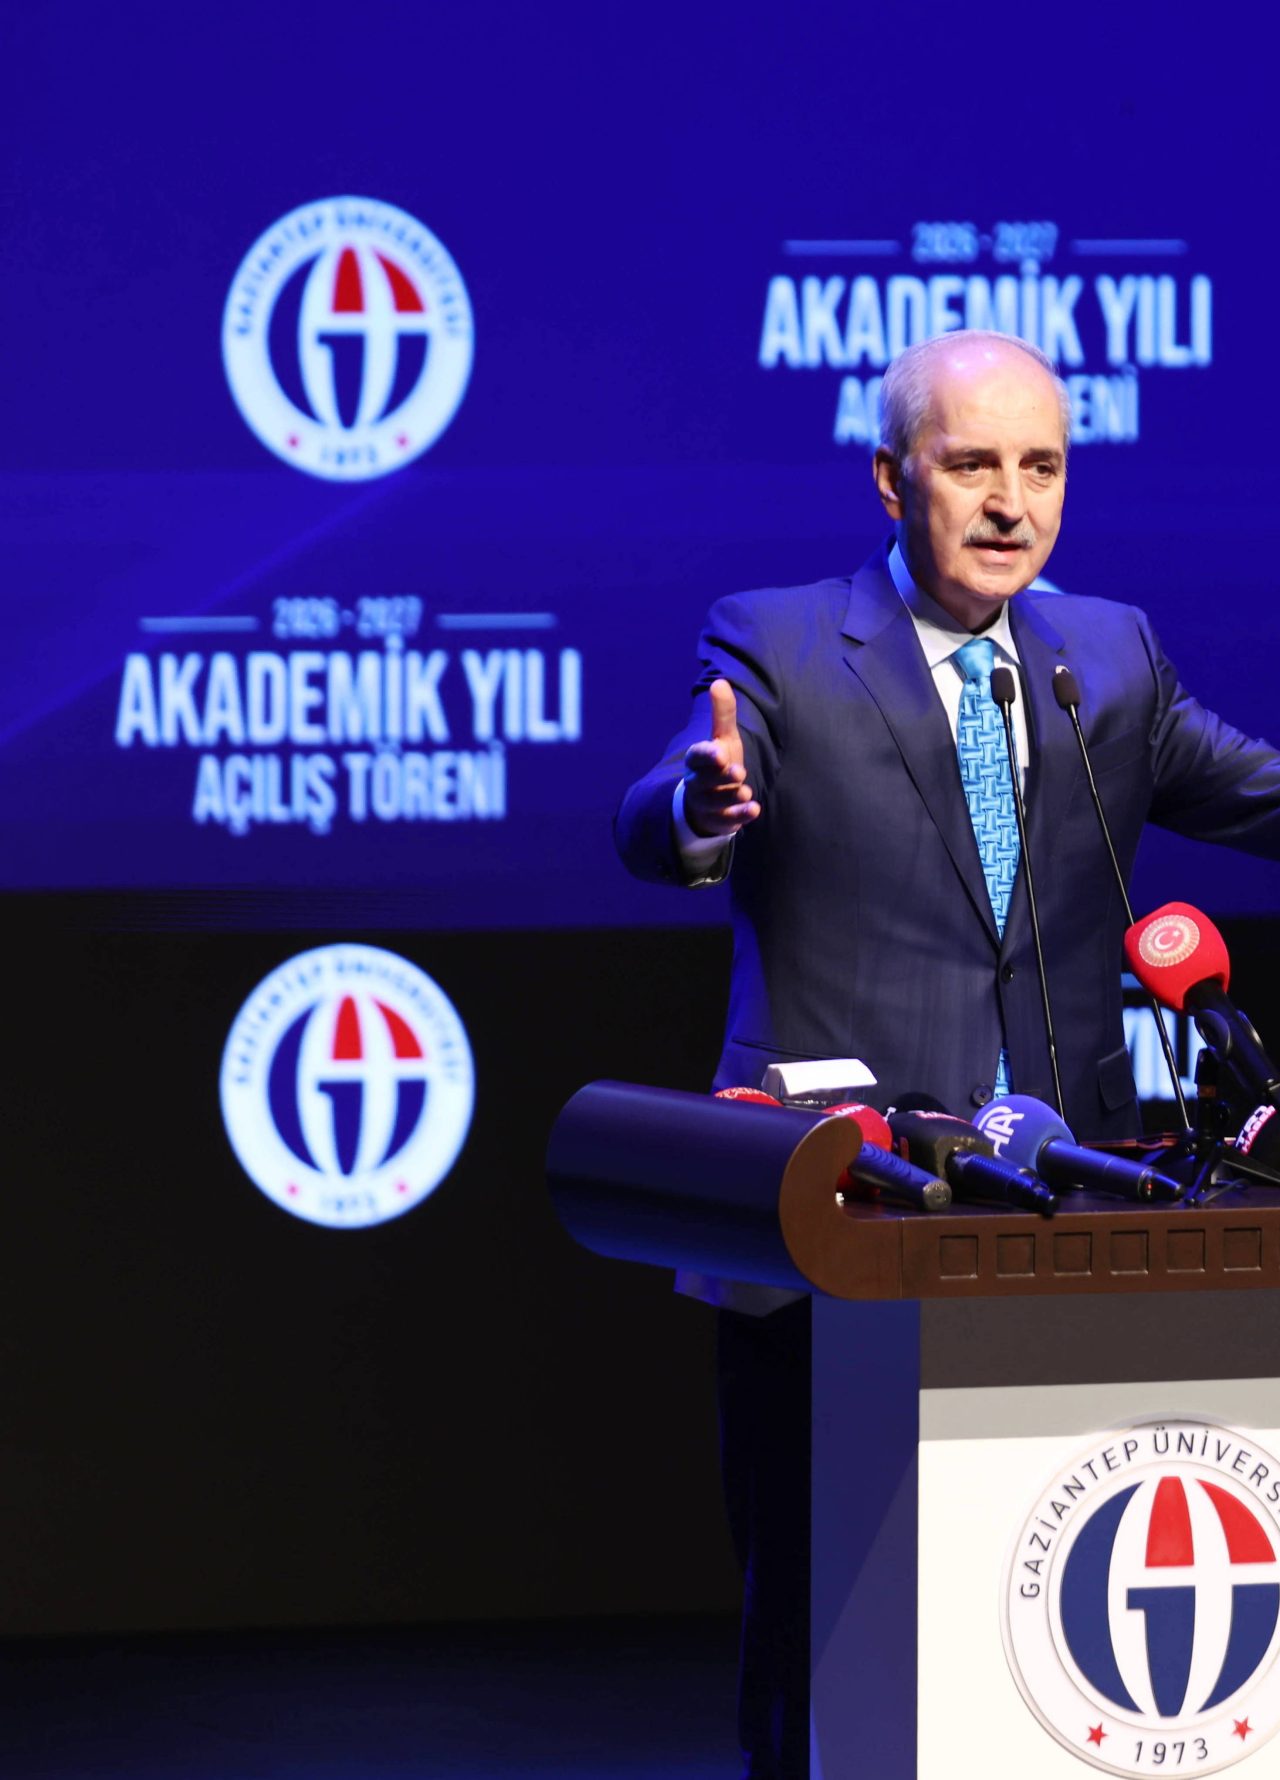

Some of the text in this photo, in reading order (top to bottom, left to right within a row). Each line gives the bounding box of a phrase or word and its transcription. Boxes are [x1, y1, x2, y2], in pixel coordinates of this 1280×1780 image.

[1097, 275, 1212, 368] YILI
[115, 633, 581, 747] AKADEMİK YILI
[193, 739, 506, 835] AÇILIŞ TÖRENİ
[1020, 1438, 1139, 1599] GAZİANTEP
[1134, 1737, 1209, 1765] 1973
